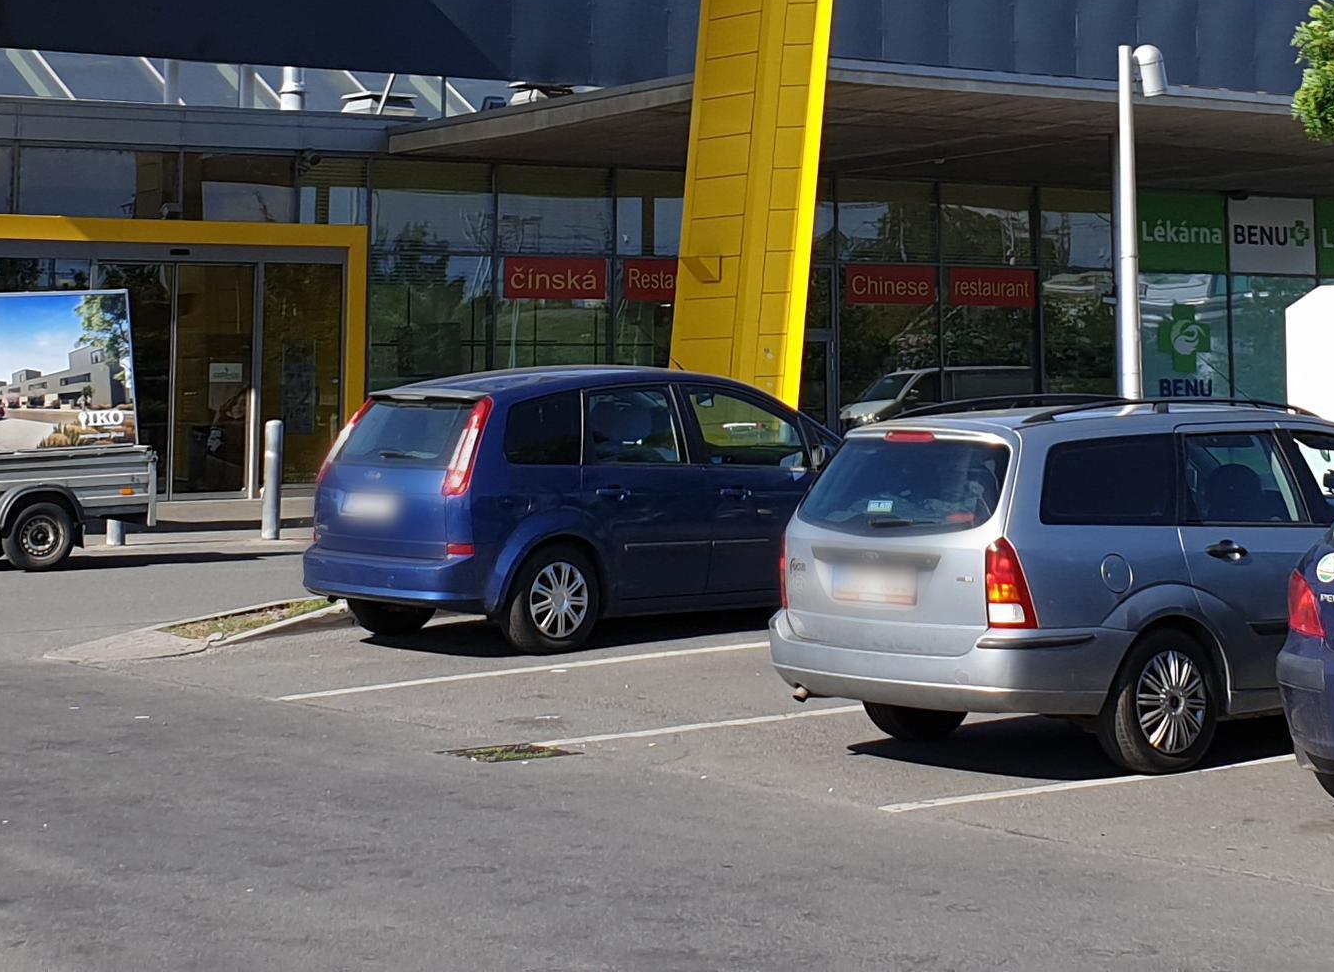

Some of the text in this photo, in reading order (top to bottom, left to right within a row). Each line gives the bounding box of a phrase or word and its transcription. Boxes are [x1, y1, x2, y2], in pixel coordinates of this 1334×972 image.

[1141, 220, 1223, 246] Lékárna
[1233, 224, 1289, 247] BENU
[510, 266, 597, 291] čínská
[851, 275, 1030, 299] Chinese restaurant
[1158, 378, 1213, 398] BENU
